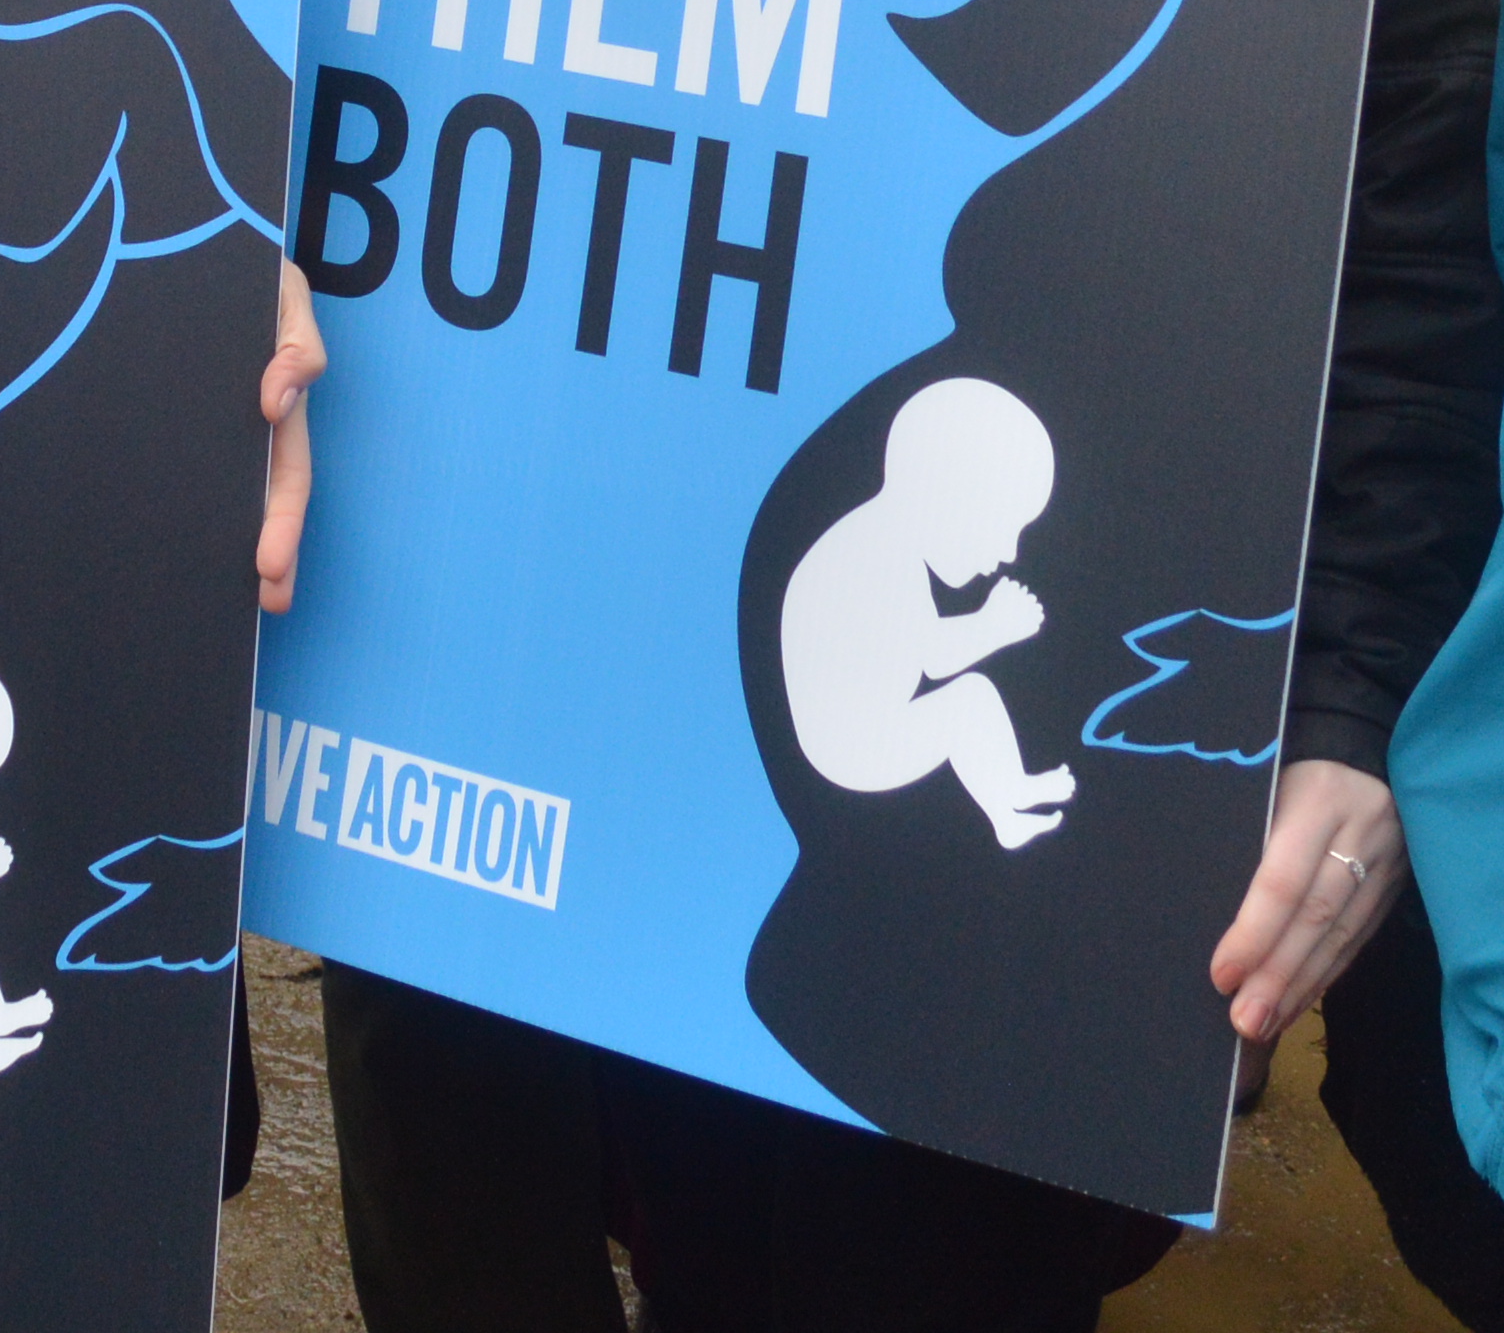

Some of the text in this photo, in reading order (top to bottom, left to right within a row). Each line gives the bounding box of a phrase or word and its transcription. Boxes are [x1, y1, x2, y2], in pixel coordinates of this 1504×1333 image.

[293, 64, 809, 395] BOTH
[249, 707, 559, 899] IVE ACTION
